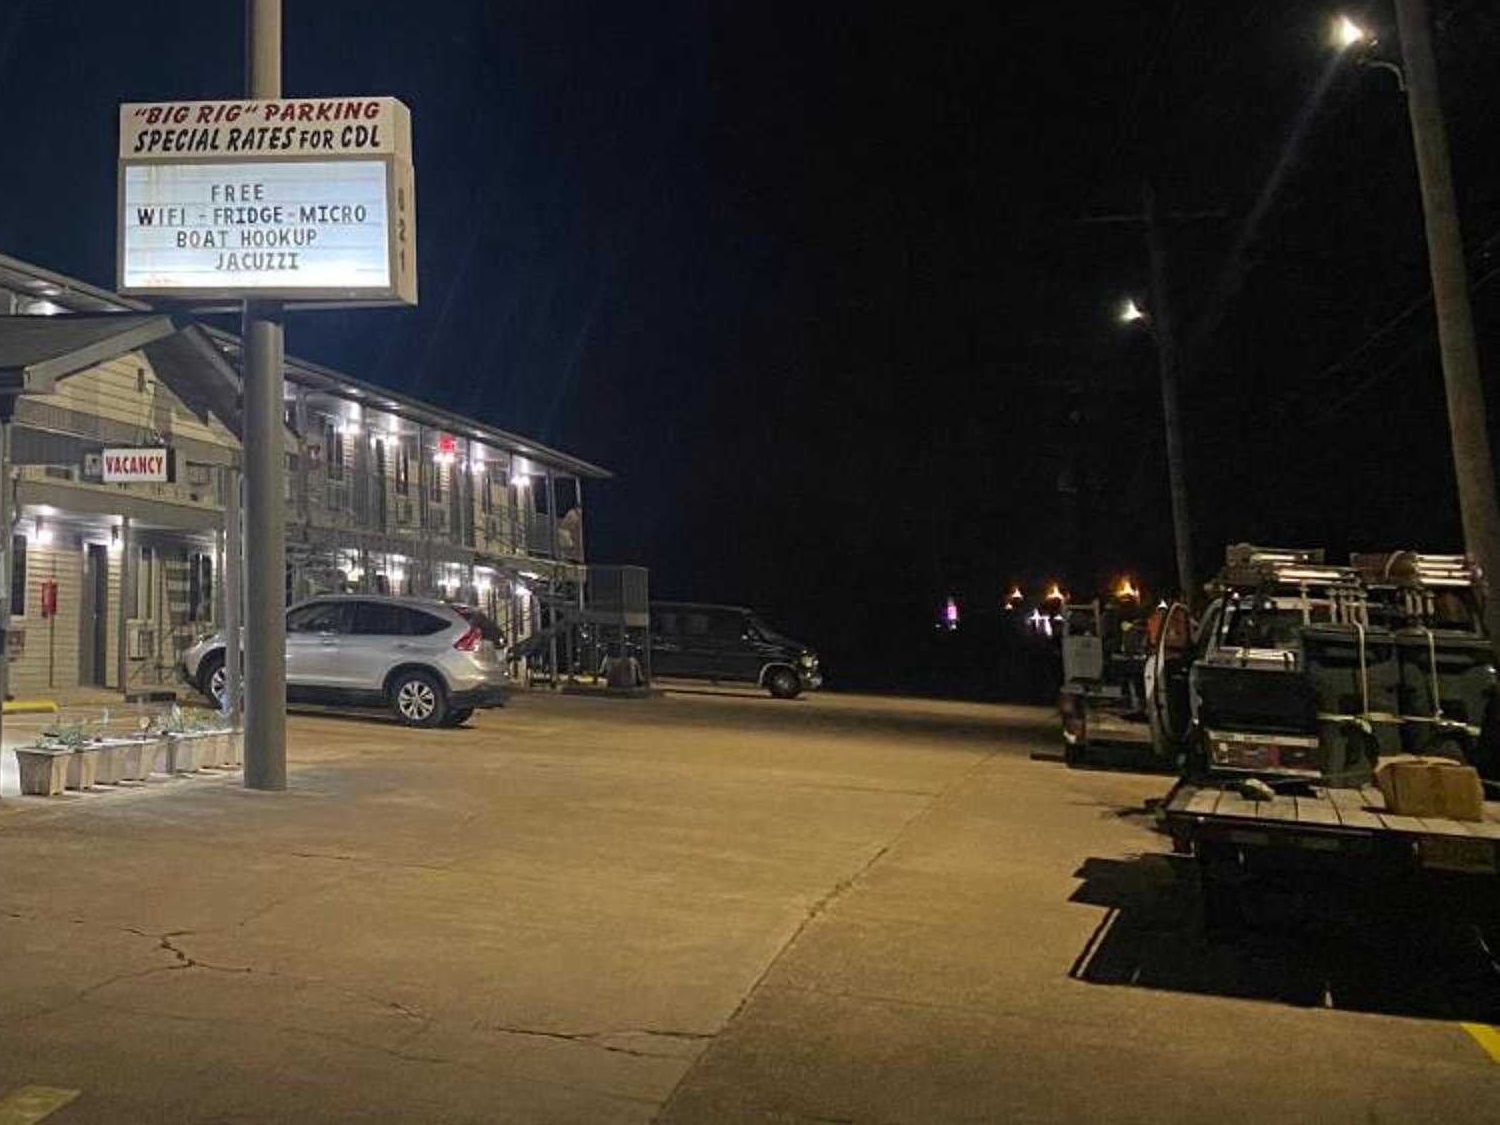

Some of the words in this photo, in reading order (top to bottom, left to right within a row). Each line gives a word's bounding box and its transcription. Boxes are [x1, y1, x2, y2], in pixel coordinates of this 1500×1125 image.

[264, 101, 380, 122] PARKING
[134, 127, 219, 153] SPECIAL
[227, 126, 296, 151] RATES
[300, 129, 334, 149] FOR
[341, 124, 380, 148] CDL
[211, 184, 264, 203] FREE
[137, 207, 185, 226] WIFI
[177, 230, 229, 249] BOAT
[241, 228, 317, 248] HOOKUP
[215, 252, 300, 271] JACUZZI
[105, 456, 163, 475] VACANCY
